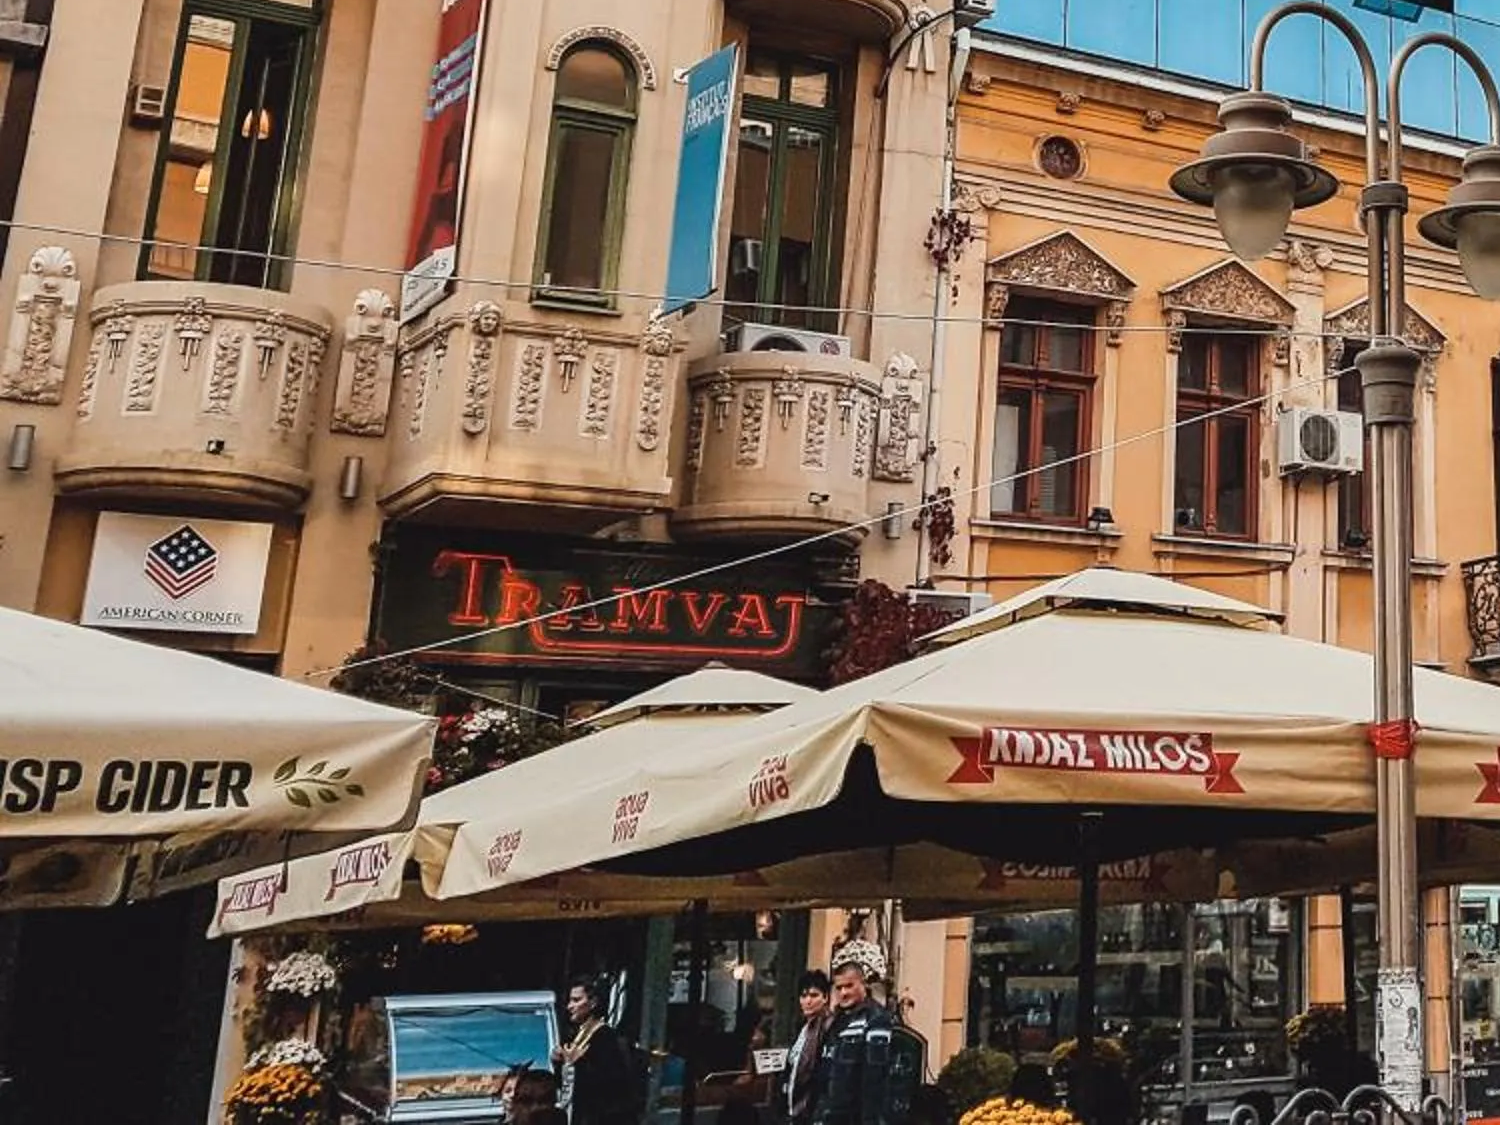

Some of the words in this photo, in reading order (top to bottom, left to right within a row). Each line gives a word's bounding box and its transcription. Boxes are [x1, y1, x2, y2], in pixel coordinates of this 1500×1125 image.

[99, 606, 177, 622] AMERICAN
[182, 609, 243, 624] CORNER
[989, 728, 1094, 768] KNJAZ
[96, 759, 254, 813] CIDER
[749, 775, 789, 807] viva
